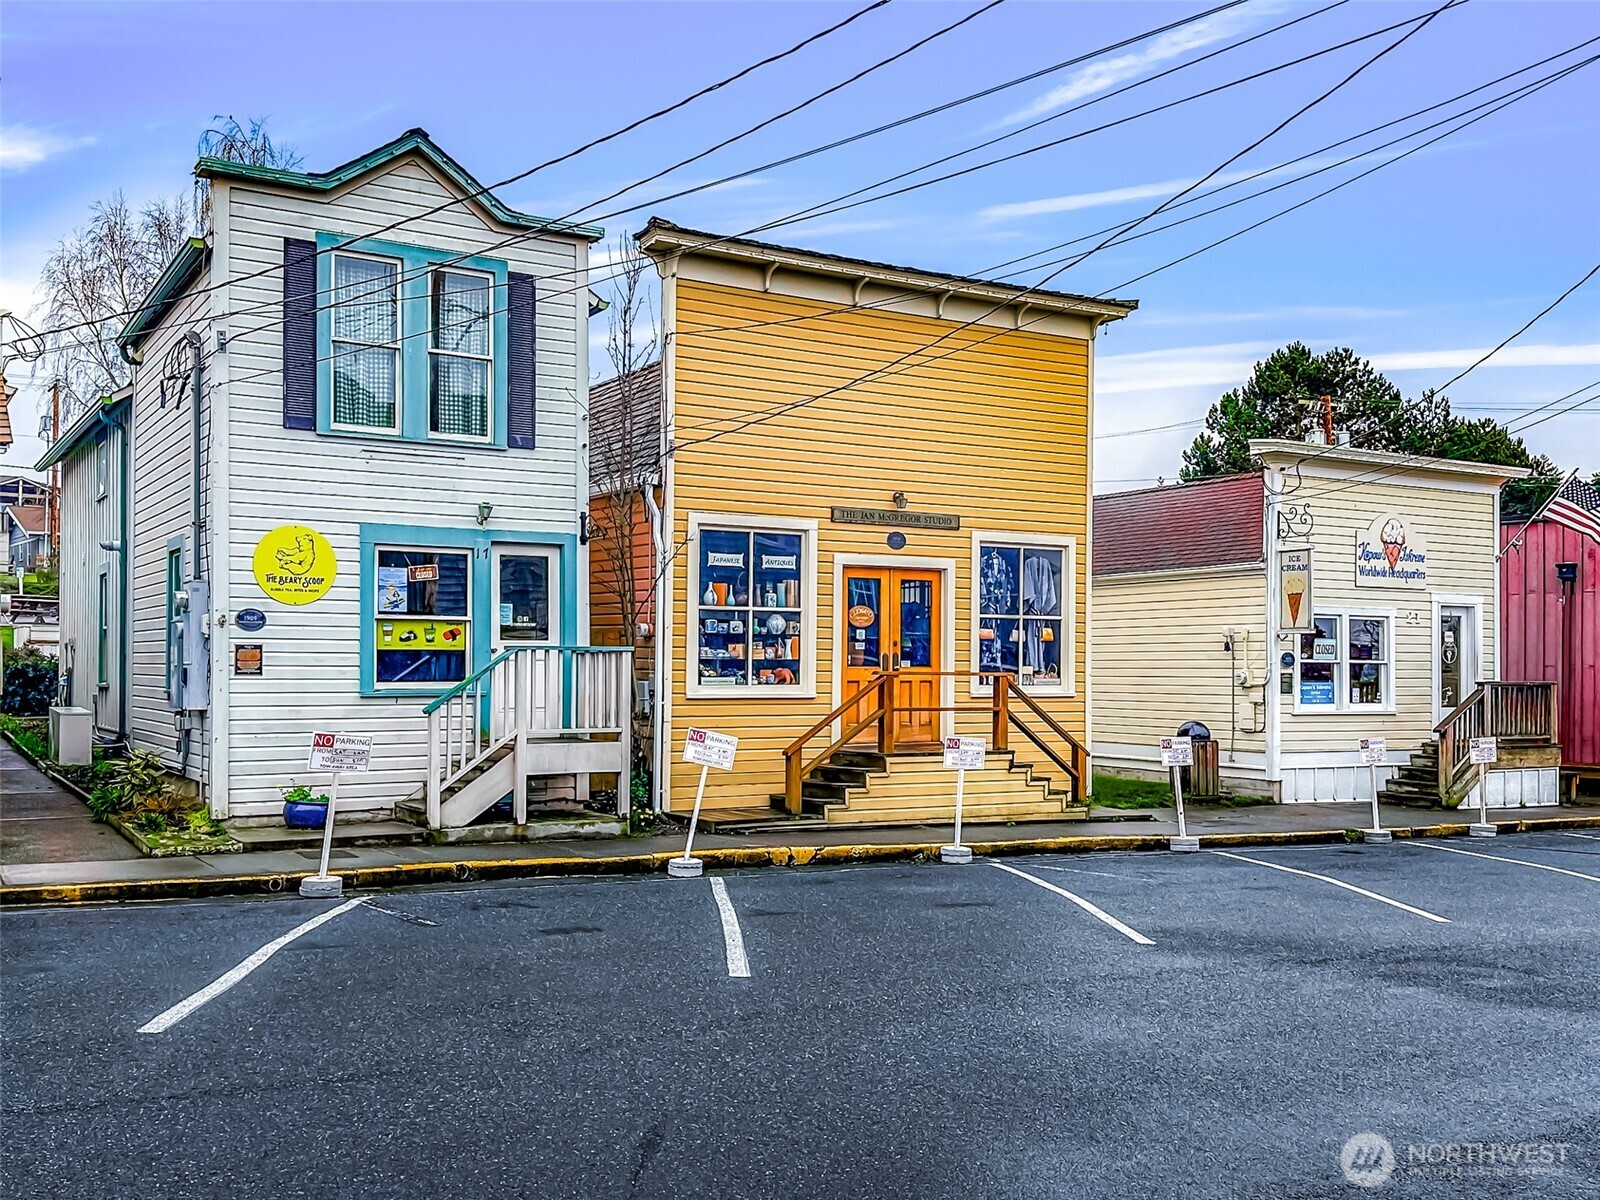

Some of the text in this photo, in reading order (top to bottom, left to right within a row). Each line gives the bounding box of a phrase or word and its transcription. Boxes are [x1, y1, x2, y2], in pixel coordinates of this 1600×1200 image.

[841, 510, 858, 519] THE
[860, 512, 875, 520] JAN
[924, 516, 953, 526] STUDIO
[711, 555, 740, 564] JAPANESE
[764, 558, 794, 566] ANTIQUES
[1288, 555, 1302, 563] ICE
[1281, 564, 1309, 572] CREAM
[1358, 564, 1426, 584] Worldwide Headquarters
[265, 573, 325, 588] THE BEARY SCOOP
[1406, 611, 1421, 625] 21
[1315, 643, 1335, 655] CLOSED
[314, 734, 371, 747] NO PARKING
[689, 730, 735, 747] NO PARKING
[946, 739, 985, 749] NO PARKING
[1161, 740, 1171, 748] NO
